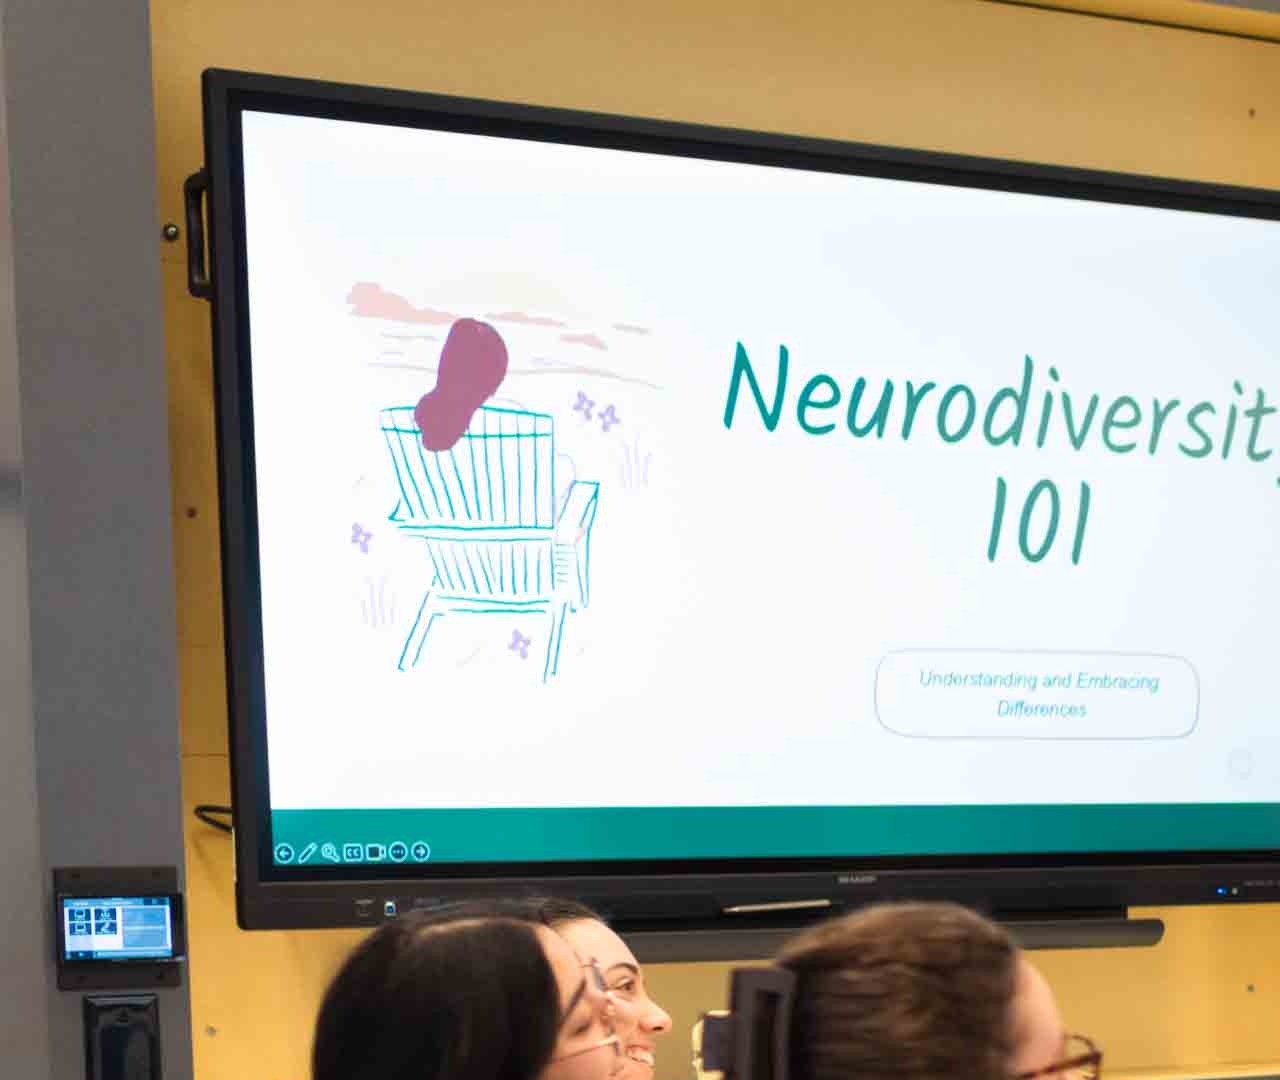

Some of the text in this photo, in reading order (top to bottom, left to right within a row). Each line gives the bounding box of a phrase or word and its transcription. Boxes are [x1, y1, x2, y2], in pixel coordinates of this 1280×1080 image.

[986, 475, 1092, 565] 101
[919, 669, 1161, 694] Understanding and Embracing
[996, 699, 1088, 719] Differences
